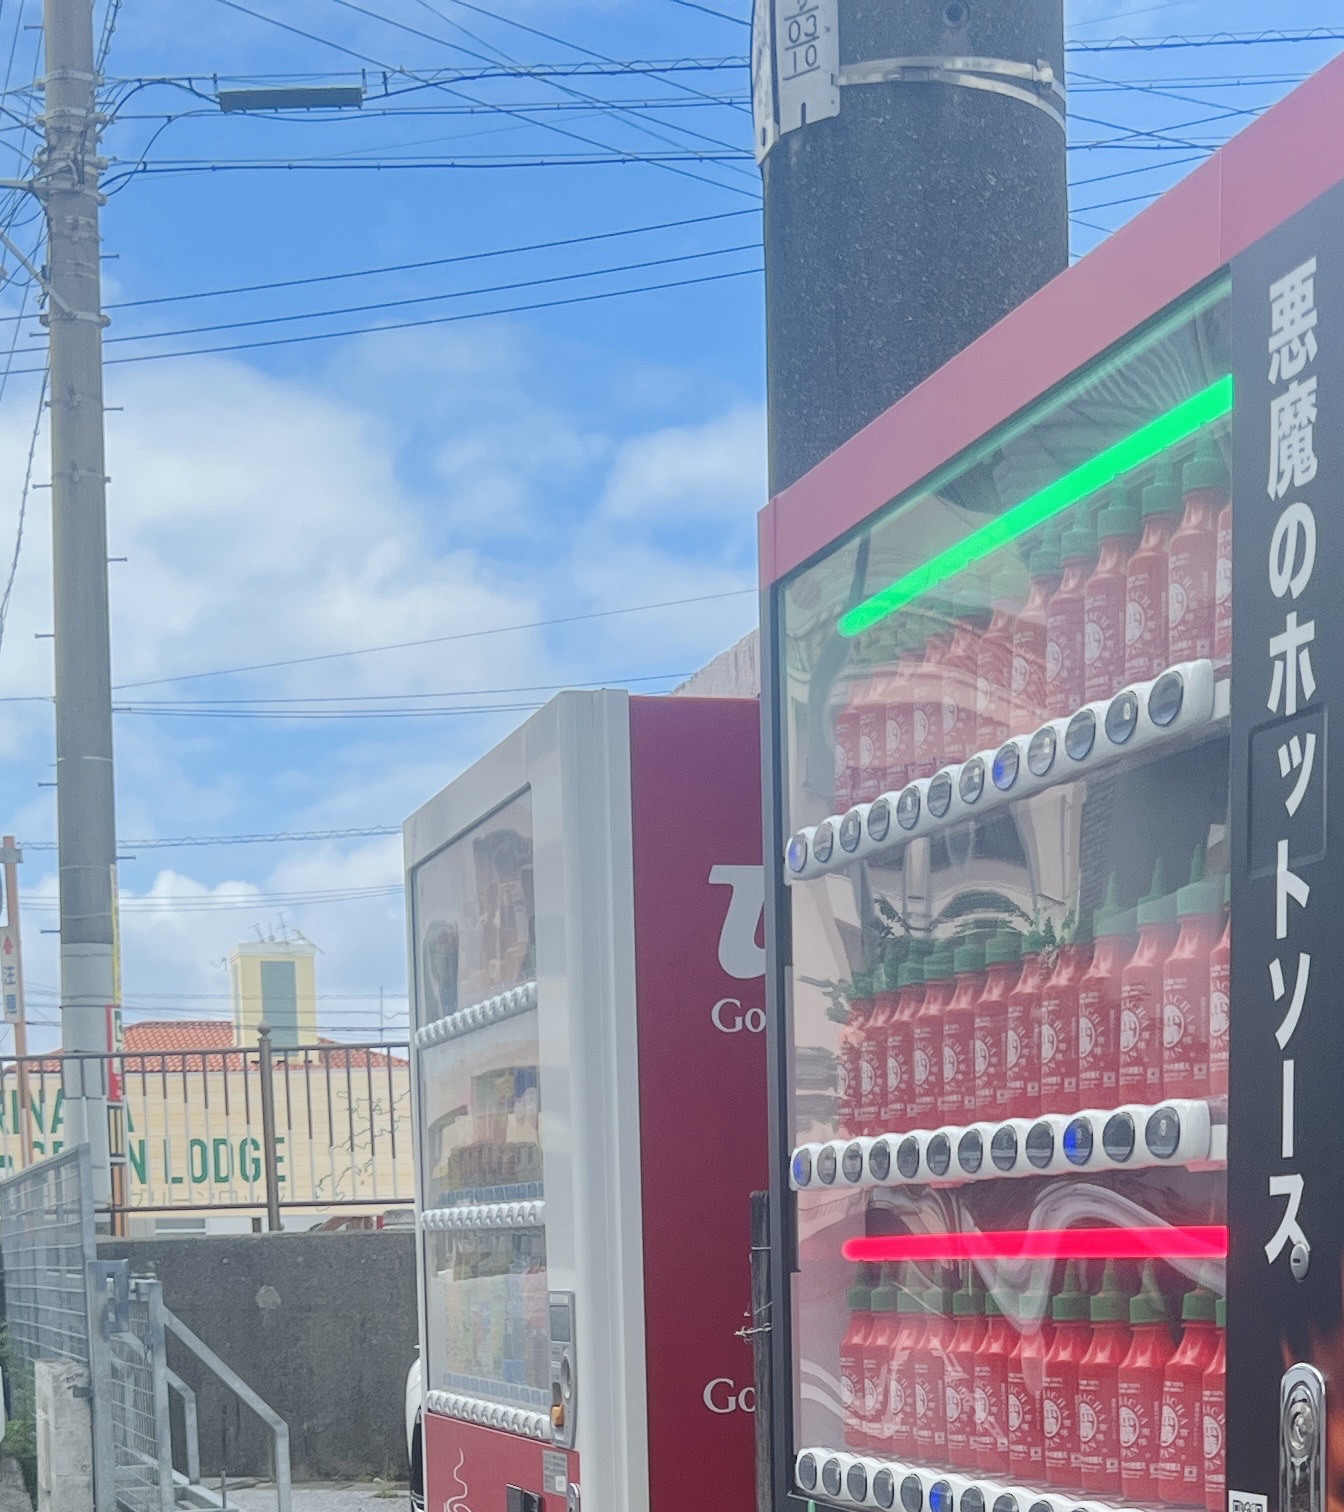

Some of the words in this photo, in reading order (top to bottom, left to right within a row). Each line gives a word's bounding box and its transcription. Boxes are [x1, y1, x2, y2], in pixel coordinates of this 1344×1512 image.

[789, 15, 817, 43] 03
[794, 45, 817, 73] 10
[1264, 256, 1319, 1264] 悪魔のホットソース
